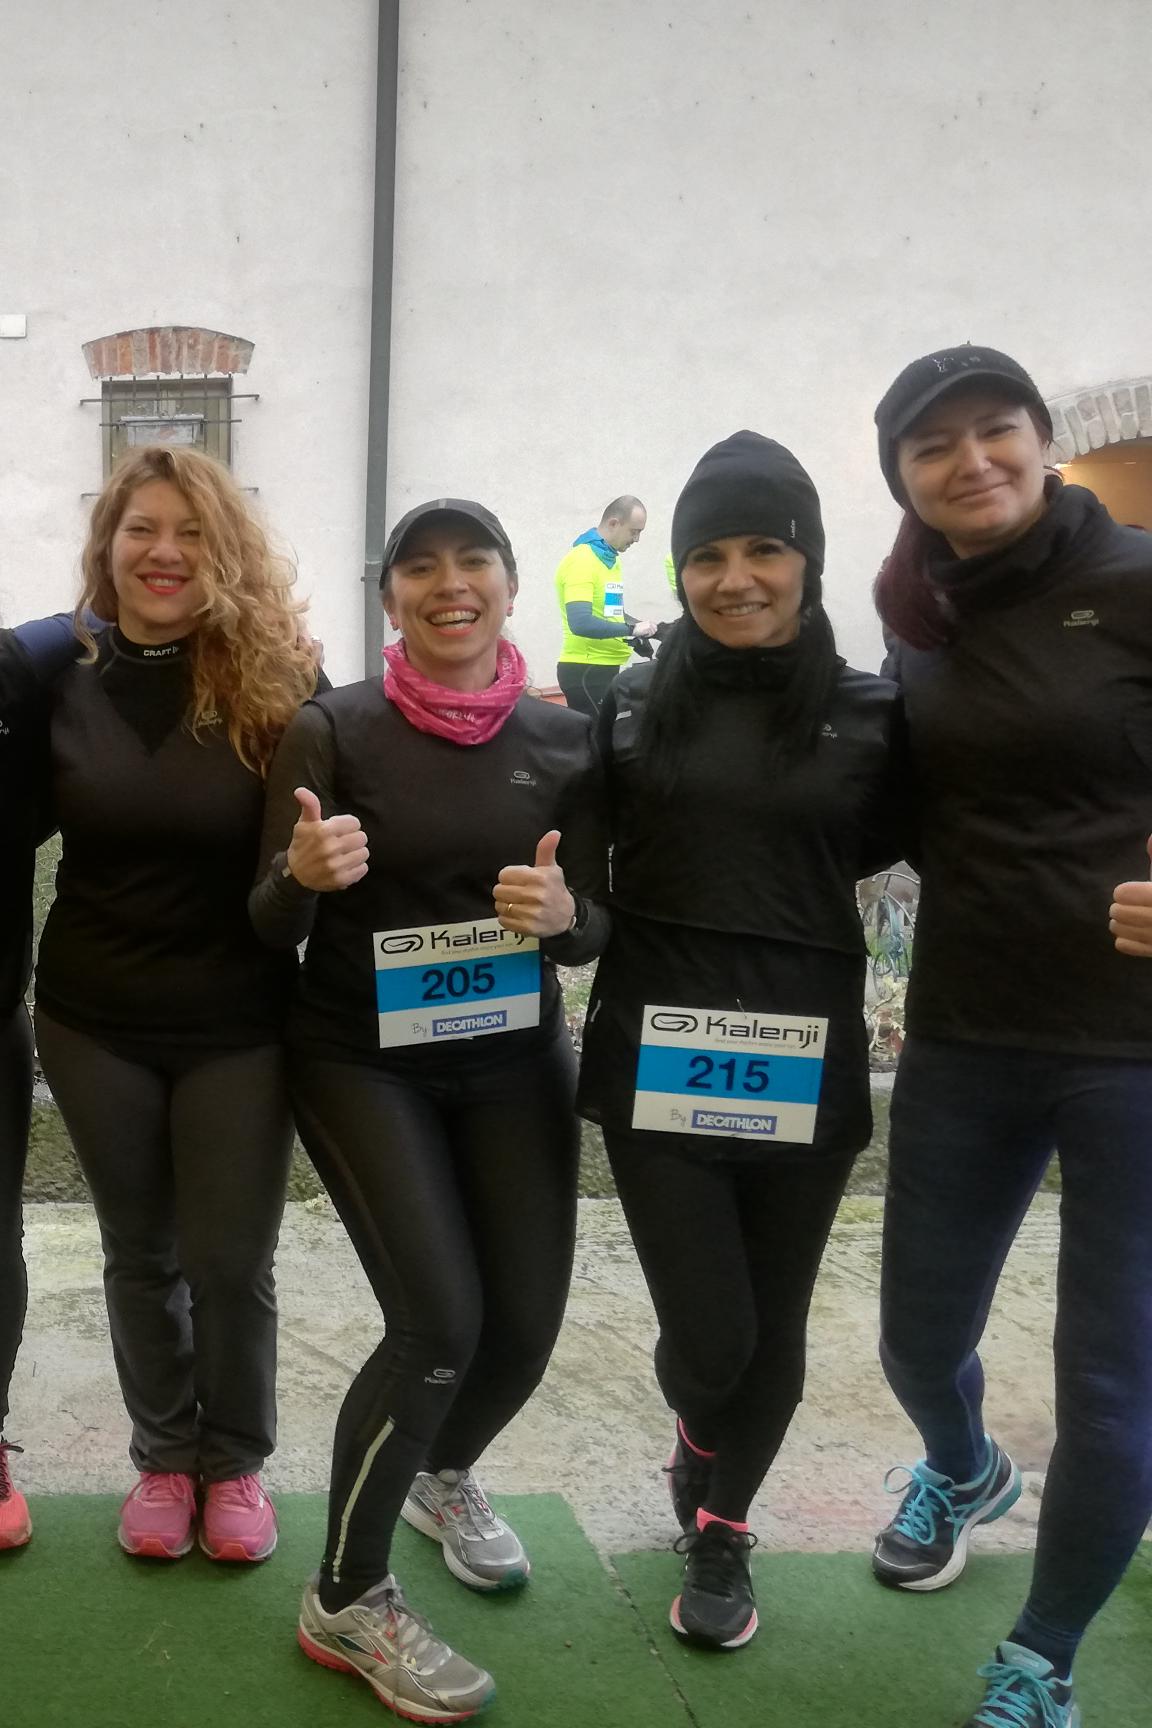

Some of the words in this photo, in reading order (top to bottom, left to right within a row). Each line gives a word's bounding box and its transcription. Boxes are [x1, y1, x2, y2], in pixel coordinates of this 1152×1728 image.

[143, 648, 172, 657] CRAFT
[430, 926, 526, 950] Kalenj
[421, 962, 496, 1001] 205
[436, 1013, 504, 1033] DECATHLON
[705, 1015, 820, 1049] Kalenji
[685, 1055, 770, 1093] 215
[696, 1113, 772, 1131] DECATHLON
